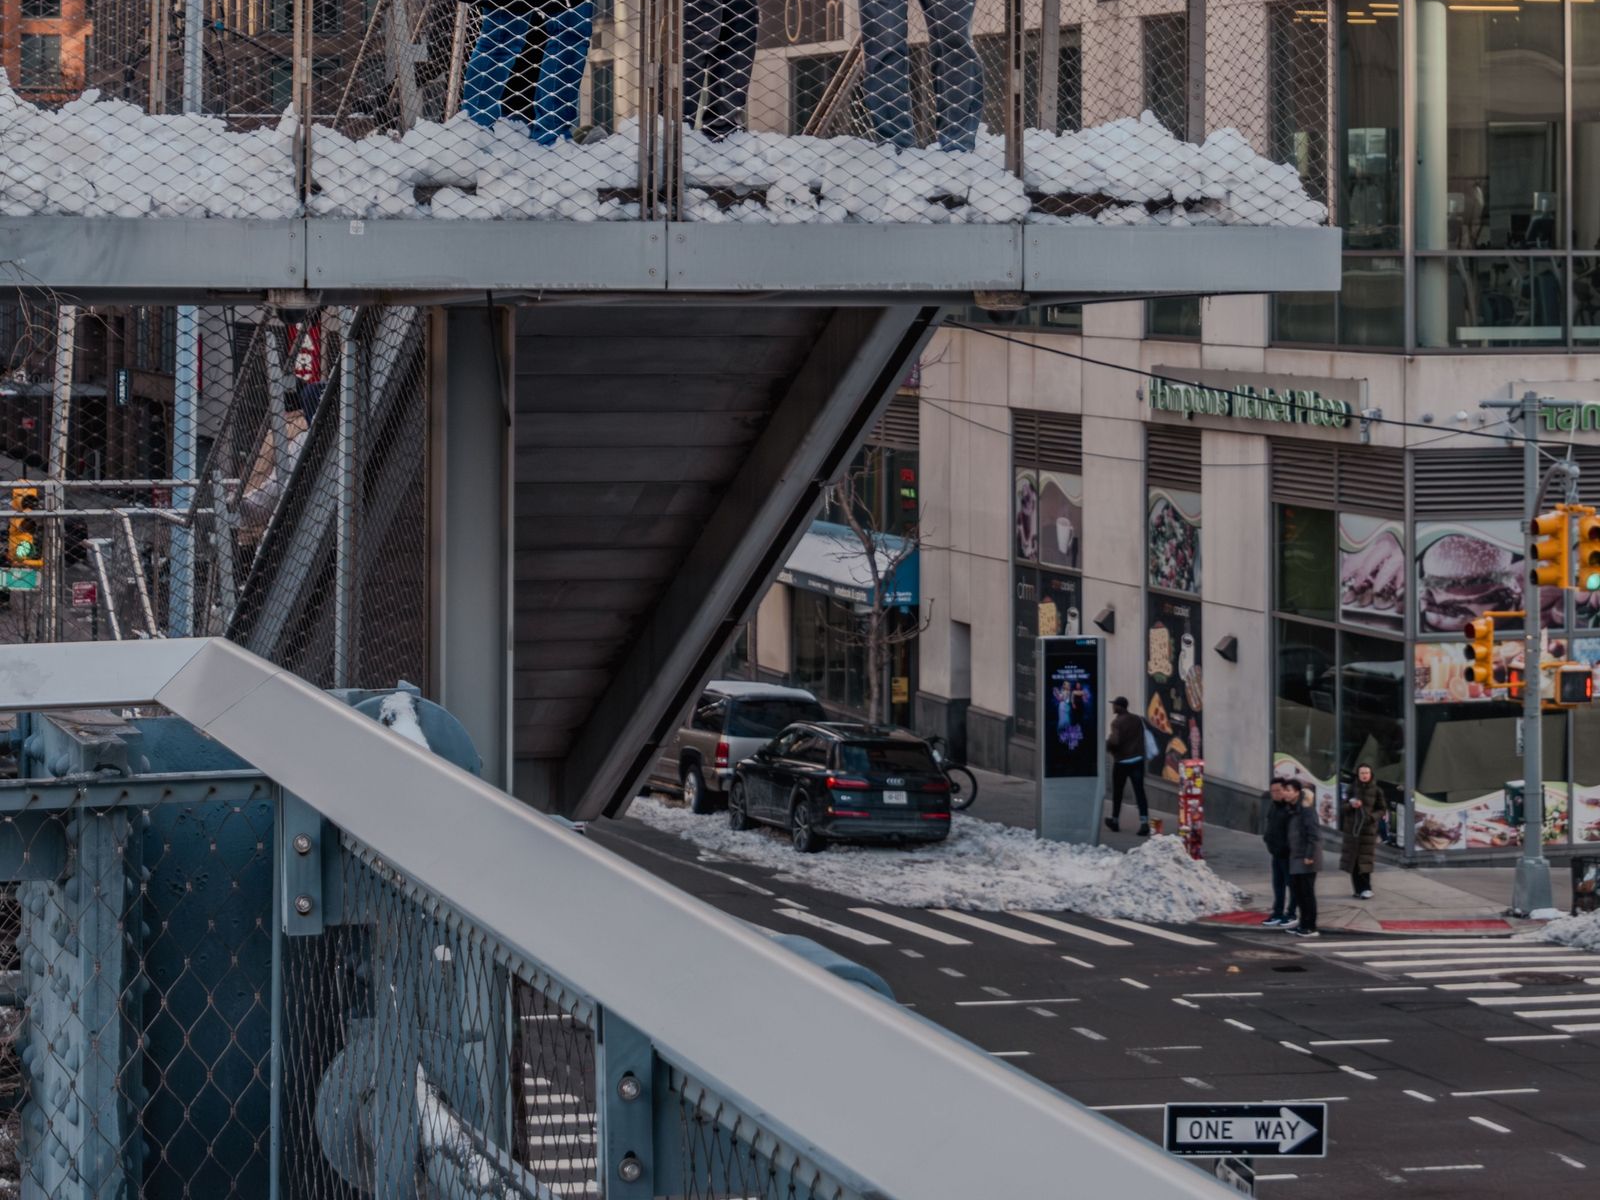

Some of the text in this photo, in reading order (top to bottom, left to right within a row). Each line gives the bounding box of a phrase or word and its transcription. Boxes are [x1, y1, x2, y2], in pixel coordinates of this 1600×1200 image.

[1148, 376, 1349, 429] Hamptons Market Place
[1189, 1120, 1301, 1140] ONE WAY
